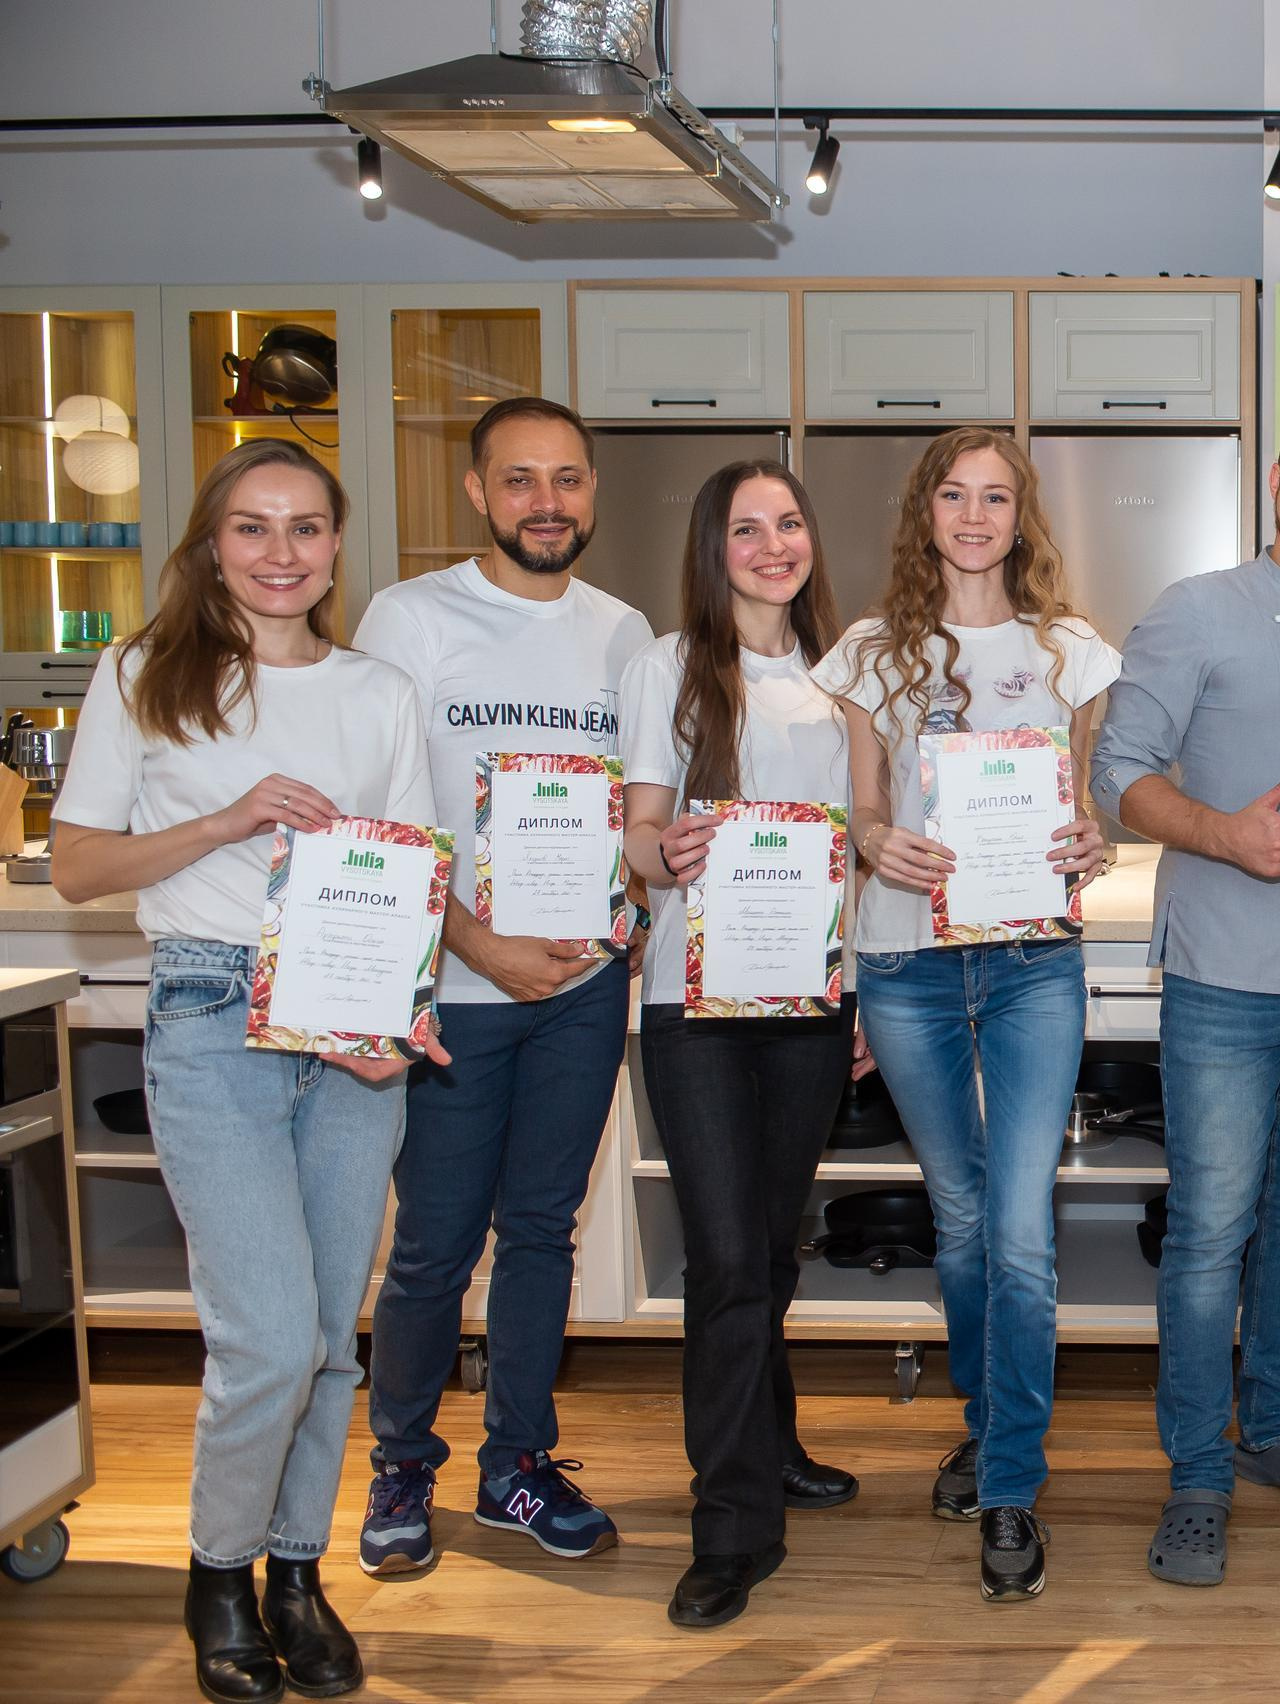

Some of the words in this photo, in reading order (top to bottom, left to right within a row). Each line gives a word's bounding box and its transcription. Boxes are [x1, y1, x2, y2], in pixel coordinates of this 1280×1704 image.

[447, 703, 522, 727] CALVIN
[527, 704, 577, 731] KLEIN
[967, 794, 1033, 812] ДИПЛОМ
[517, 817, 583, 831] ДИПЛОМ
[732, 869, 802, 883] ДИПЛОМ
[318, 887, 397, 908] ДИПЛОМ
[507, 1488, 544, 1525] N
